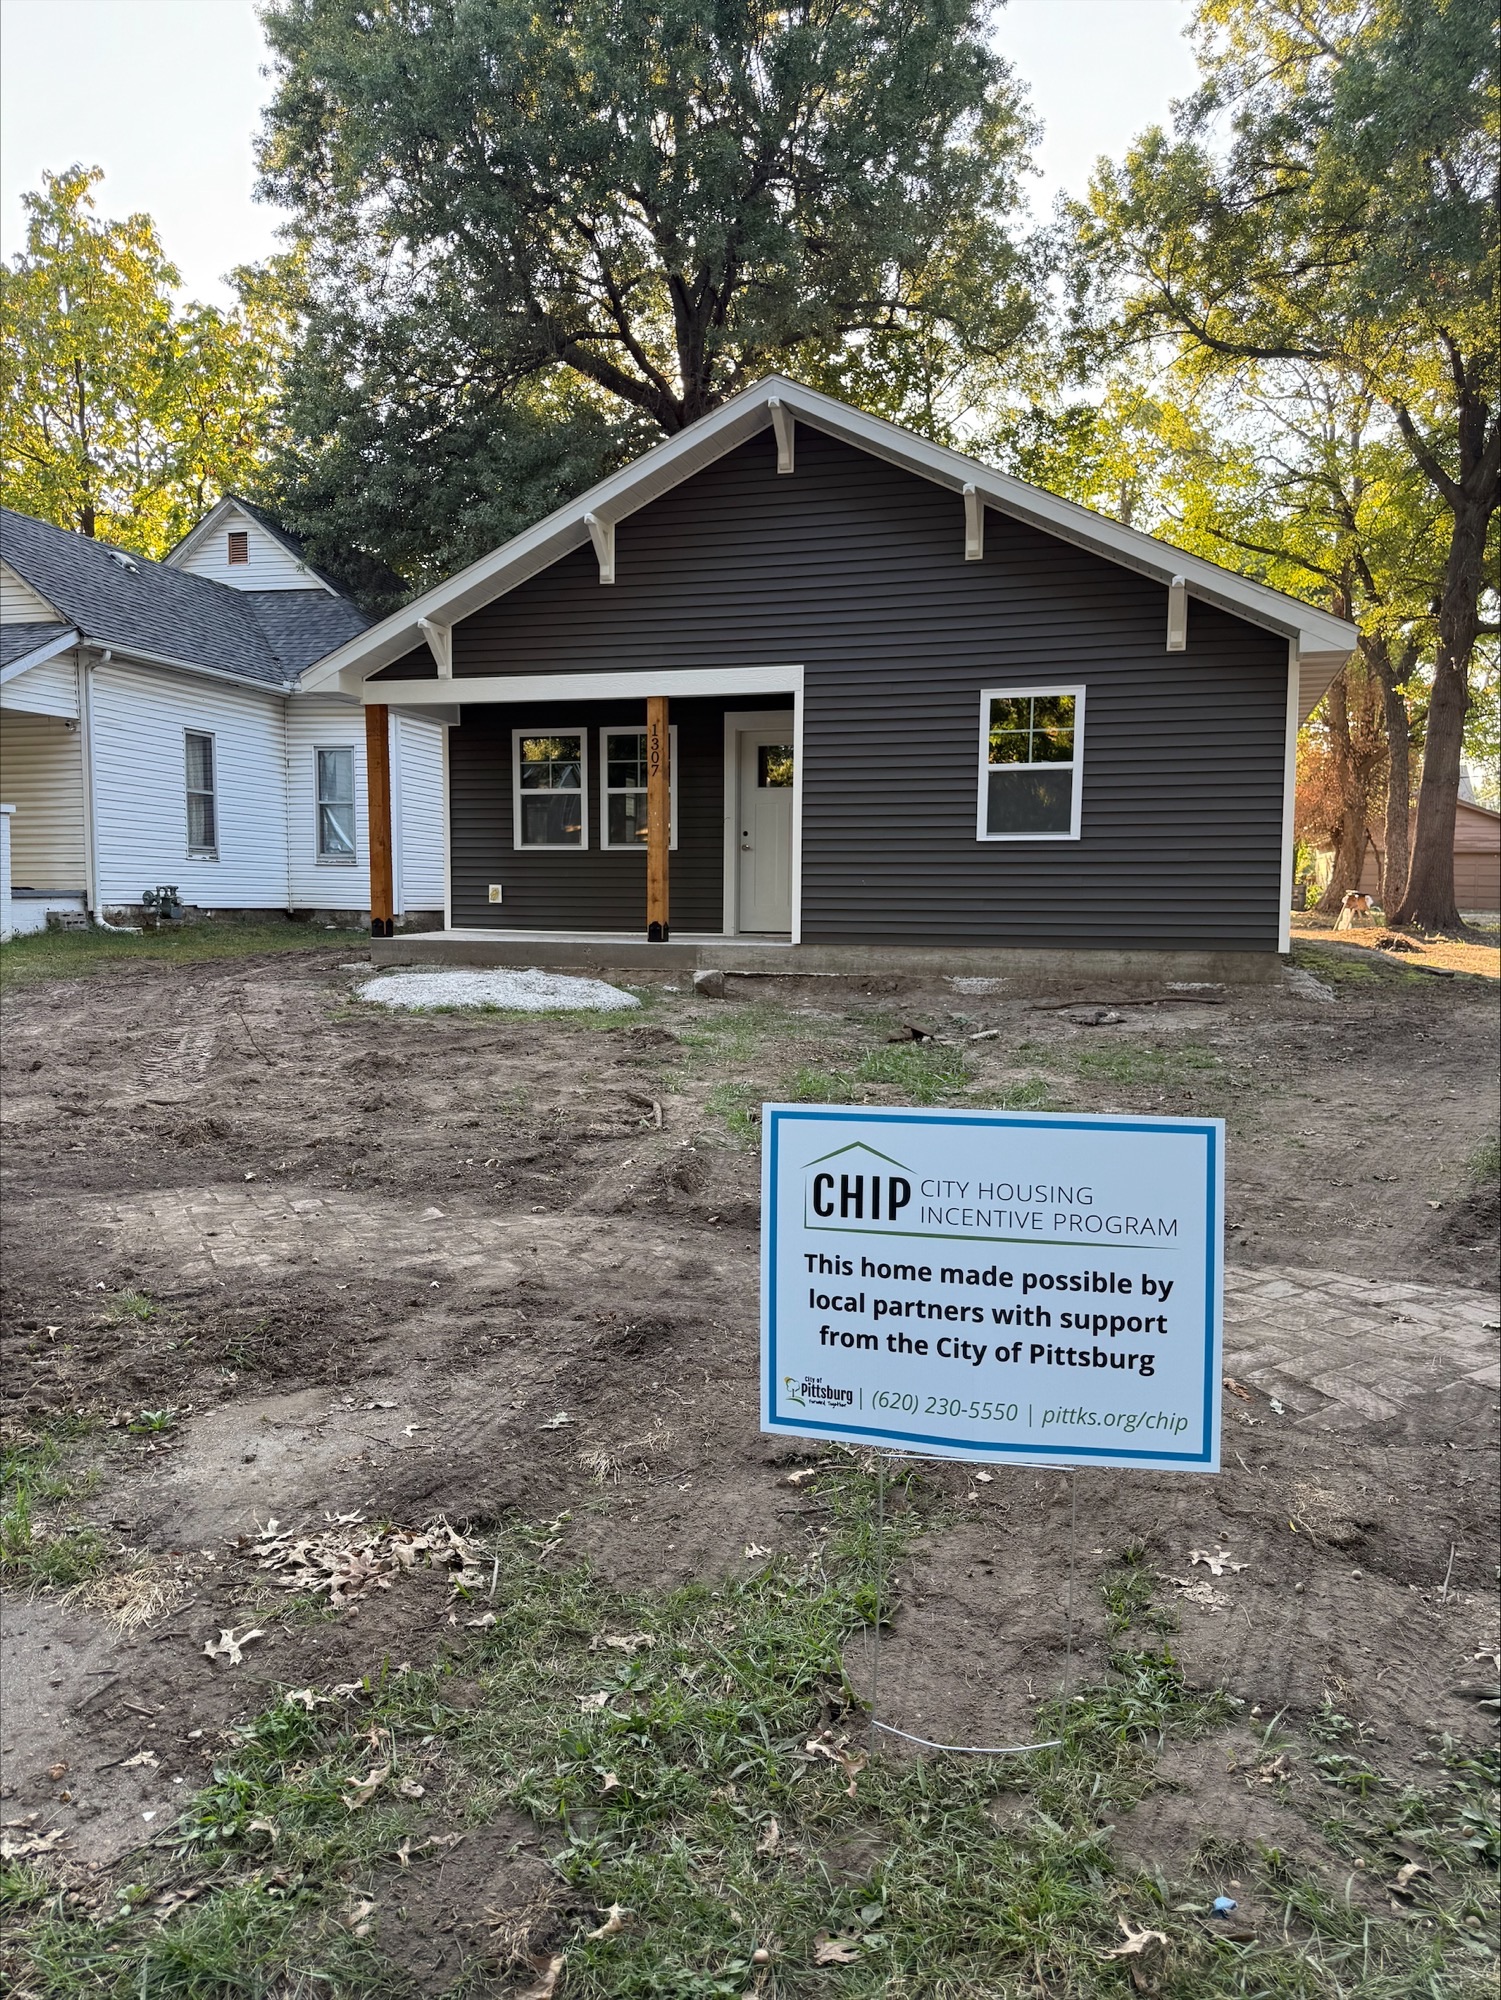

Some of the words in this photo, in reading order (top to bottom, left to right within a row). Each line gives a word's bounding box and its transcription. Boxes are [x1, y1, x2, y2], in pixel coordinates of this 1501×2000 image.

[651, 724, 660, 777] 1307
[813, 1172, 911, 1221] CHIP
[921, 1179, 969, 1199] CITY
[979, 1182, 1093, 1205] HOUSING
[921, 1207, 1043, 1230] INCENTIVE
[1054, 1213, 1177, 1237] PROGRAM
[804, 1254, 853, 1276] This
[861, 1257, 931, 1282] home
[941, 1265, 1013, 1287] made
[1023, 1268, 1132, 1295] possible
[1142, 1274, 1174, 1302] by
[809, 1289, 865, 1313] local
[873, 1294, 984, 1323] partners
[992, 1304, 1052, 1327] with
[1060, 1310, 1168, 1336] support
[819, 1326, 878, 1351] from
[887, 1333, 928, 1355] the
[937, 1337, 986, 1366] City
[995, 1342, 1023, 1361] of
[1030, 1344, 1155, 1376] Pittsburg
[801, 1383, 853, 1405] Pittsburg
[871, 1390, 919, 1414] (620)
[925, 1396, 1018, 1422] 230-5550
[1042, 1406, 1188, 1435] pittks.org/chip
